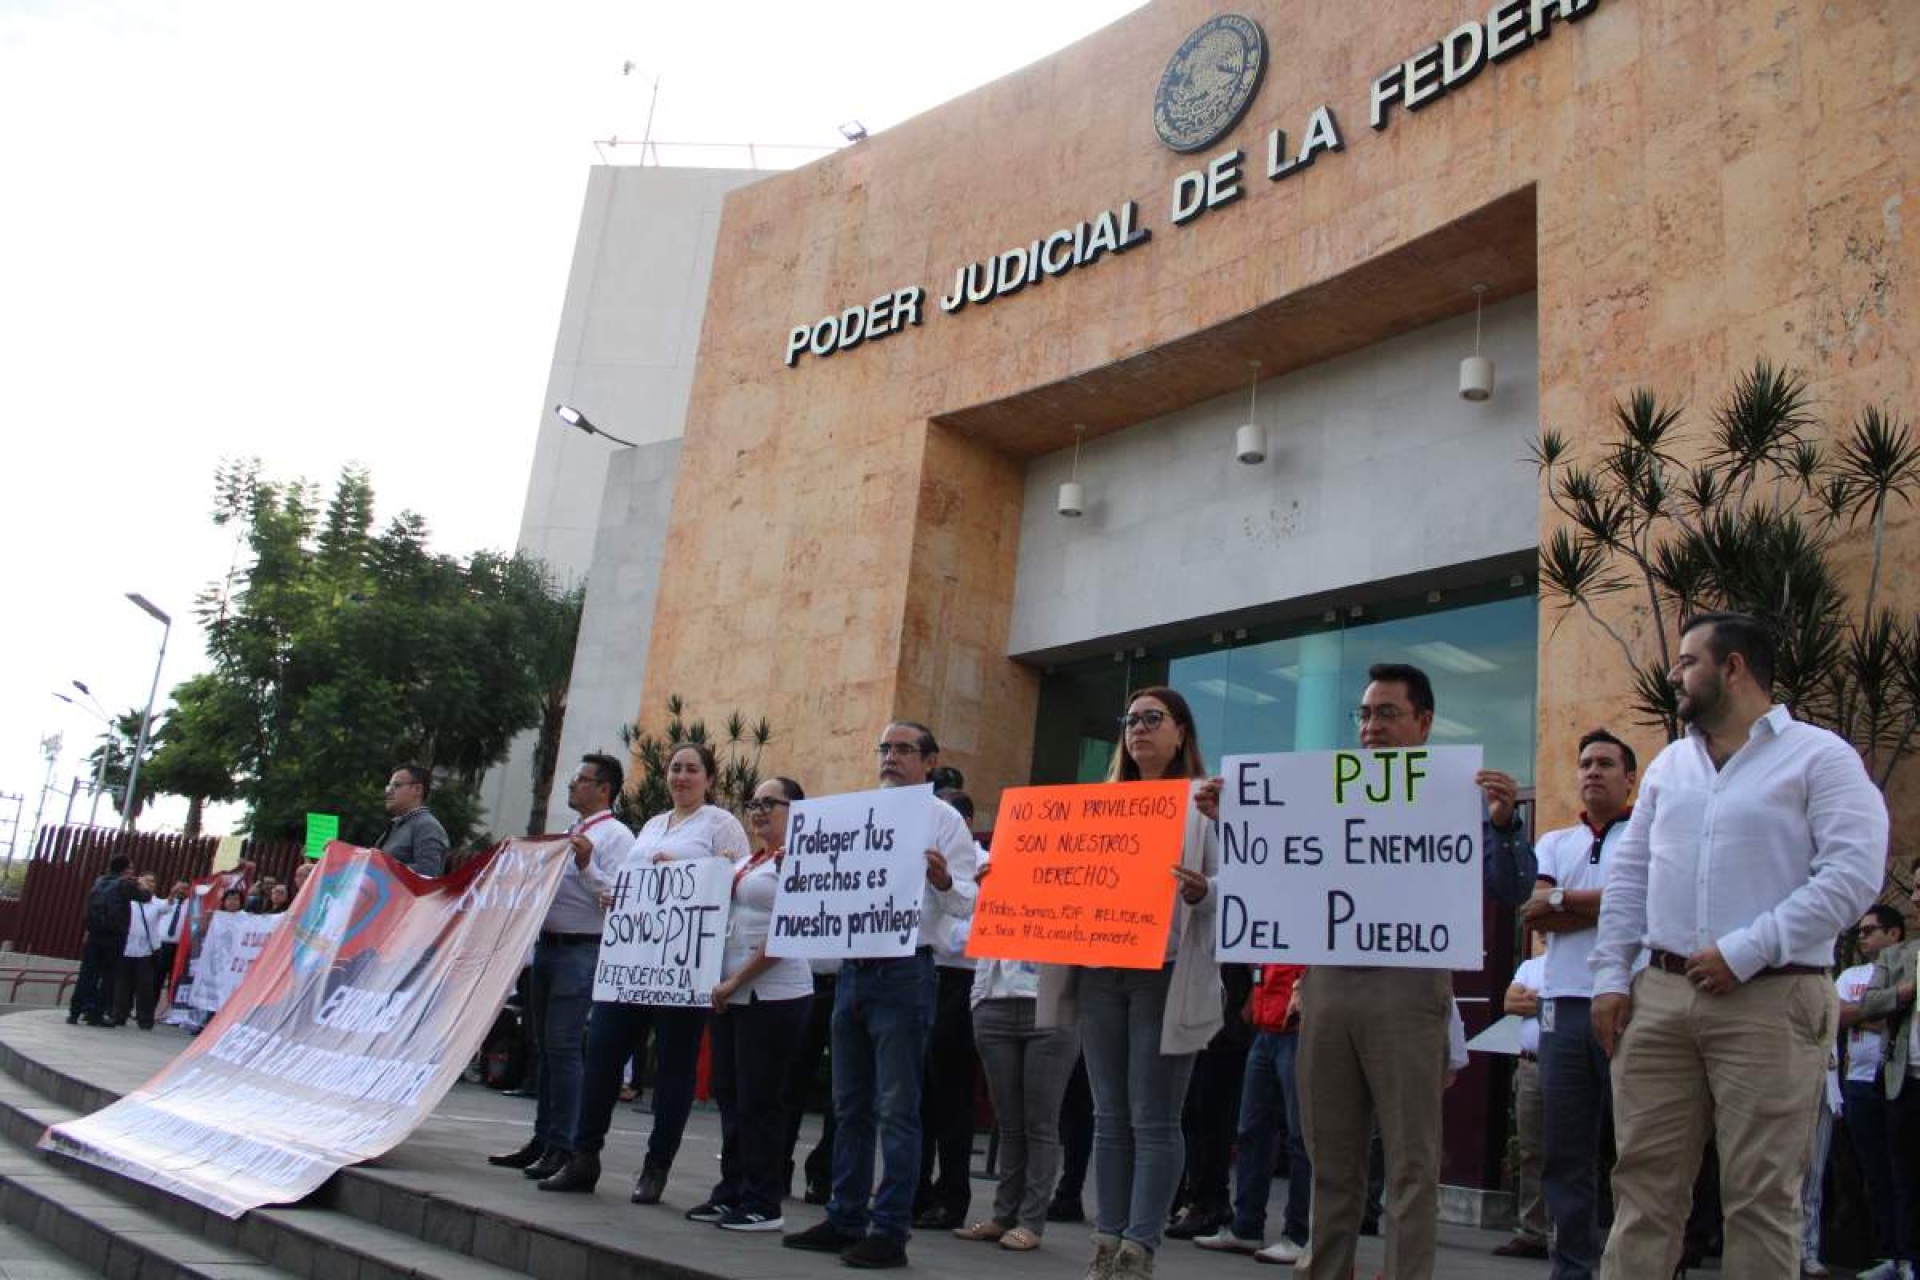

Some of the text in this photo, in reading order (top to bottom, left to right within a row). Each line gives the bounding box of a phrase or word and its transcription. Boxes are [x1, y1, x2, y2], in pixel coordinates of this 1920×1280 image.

[784, 285, 921, 366] PODER
[940, 201, 1150, 313] JUDICIAL
[1171, 149, 1243, 225] DE
[1266, 105, 1344, 179] LA
[1335, 750, 1429, 805] PJF
[1009, 795, 1178, 822] NO SON PRIVILEGIOS
[788, 807, 896, 862] Proteger tus
[1014, 832, 1141, 856] SON NUESTROS
[609, 863, 697, 913] #TODOS
[783, 866, 888, 894] derechos es
[1032, 865, 1121, 889] DERECHOS
[774, 900, 843, 938] nuestro
[597, 960, 692, 989] DEFENDEMOS LA
